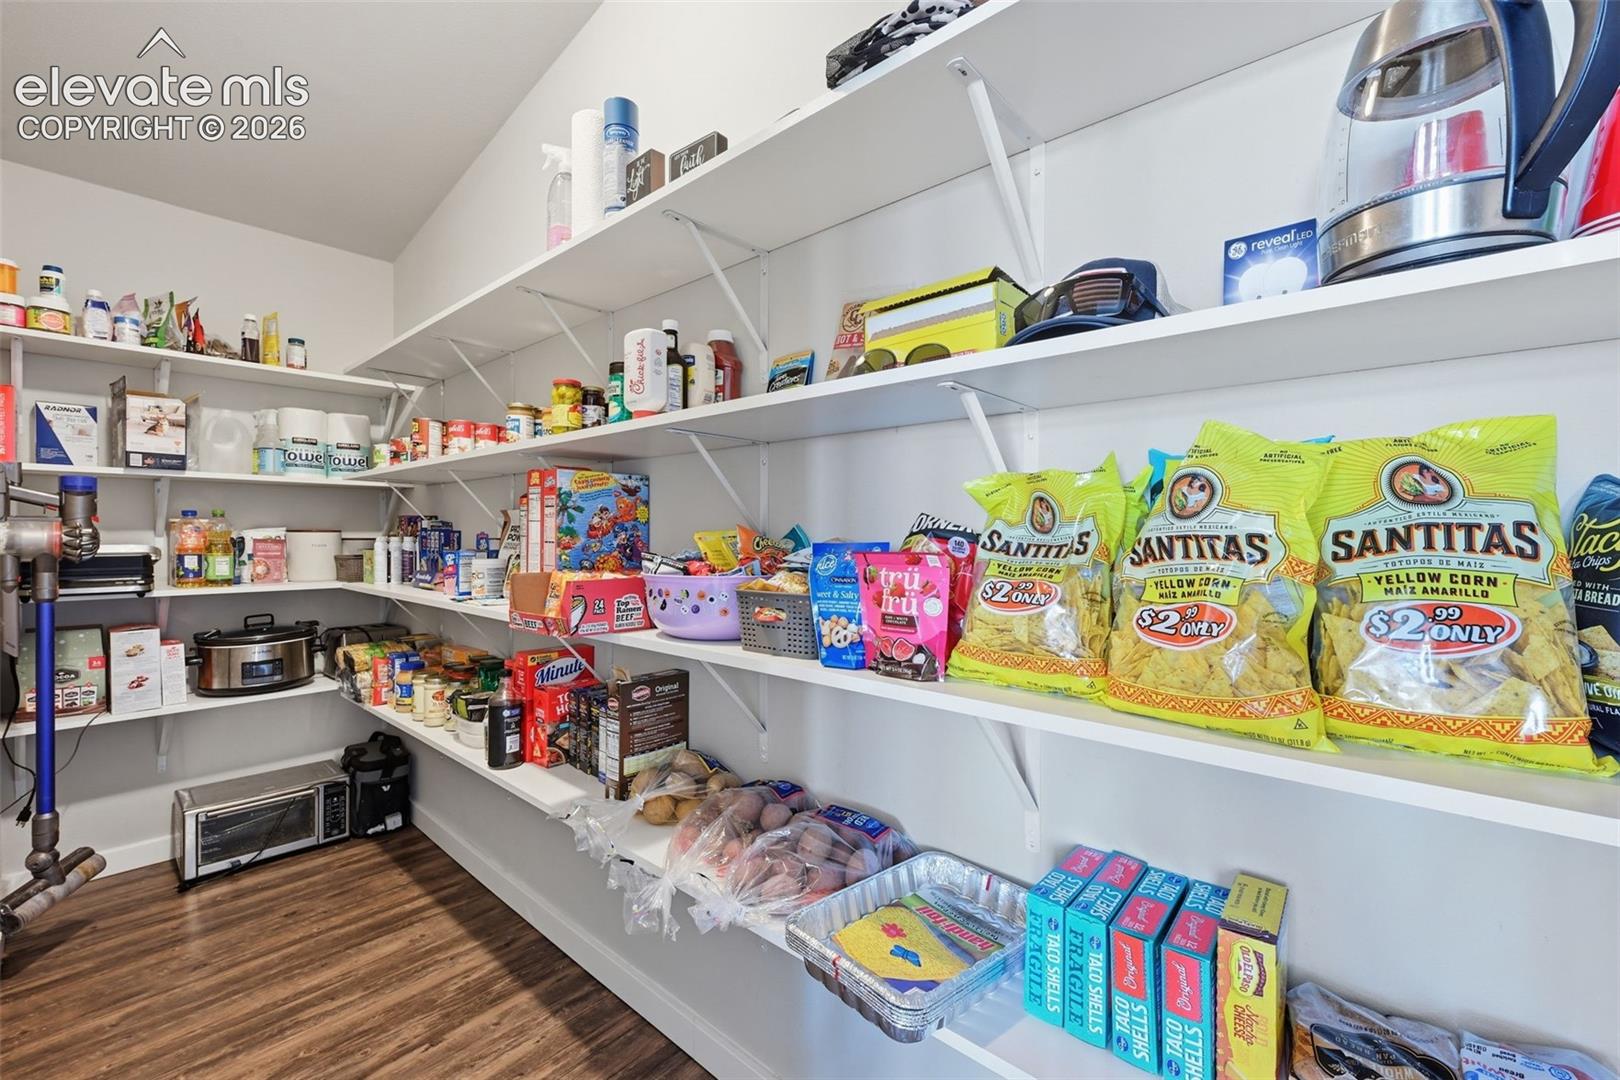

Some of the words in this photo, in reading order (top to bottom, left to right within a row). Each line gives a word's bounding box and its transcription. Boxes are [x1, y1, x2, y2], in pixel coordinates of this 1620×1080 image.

[1252, 229, 1297, 252] reveal
[1297, 230, 1313, 241] LED
[44, 404, 82, 414] RADNOR
[328, 455, 369, 468] Towel
[1331, 520, 1541, 562] SANTITAS
[1568, 513, 1620, 559] Stac
[996, 563, 1033, 572] YELLOW
[1035, 566, 1062, 575] CORN
[1383, 559, 1433, 569] TOTOPOS
[1439, 559, 1451, 567] DE
[1582, 555, 1612, 570] Chips
[879, 566, 921, 591] trü
[1154, 578, 1196, 589] YELLOW
[1199, 577, 1230, 588] CORN
[1373, 573, 1441, 586] YELLOW
[1449, 573, 1498, 587] CORN
[1585, 581, 1610, 591] WITH
[840, 590, 858, 601] Salty
[881, 588, 919, 615] frü
[1011, 592, 1051, 606] ONLY
[1181, 590, 1222, 599] AMARILLO
[1421, 586, 1489, 599] AMARILLO
[1584, 589, 1620, 606] BREAD
[594, 599, 605, 609] 24
[616, 600, 630, 608] Top
[616, 606, 643, 614] Ramen
[615, 613, 635, 622] BEEF
[1180, 621, 1226, 638] ONLY
[1430, 623, 1505, 644] ONLY
[536, 658, 585, 687] Minute
[655, 681, 679, 693] Original
[1040, 871, 1066, 889] TACO
[1049, 877, 1083, 904] SHELLS
[1138, 870, 1166, 896] SHELLS
[1079, 884, 1105, 901] TACO
[1157, 882, 1181, 901] TACO
[1185, 882, 1212, 910] SHELLS
[1090, 888, 1122, 921] SHELLS
[1027, 911, 1042, 1008] FRAGILE
[1047, 934, 1060, 964] TACO
[1239, 945, 1252, 963] OLD
[1088, 952, 1103, 983] TACO
[1122, 941, 1139, 990] Original
[1068, 926, 1084, 1028] FRAGILE
[1176, 960, 1192, 1012] Original
[1047, 966, 1061, 1013] SHELLS
[1087, 985, 1103, 1035] SHELLS
[1115, 996, 1130, 1035] TACO
[1133, 1003, 1150, 1063] SHELLS
[1233, 1004, 1245, 1041] CHEESE
[1245, 1004, 1259, 1047] Nacho
[1166, 1019, 1183, 1059] TACO
